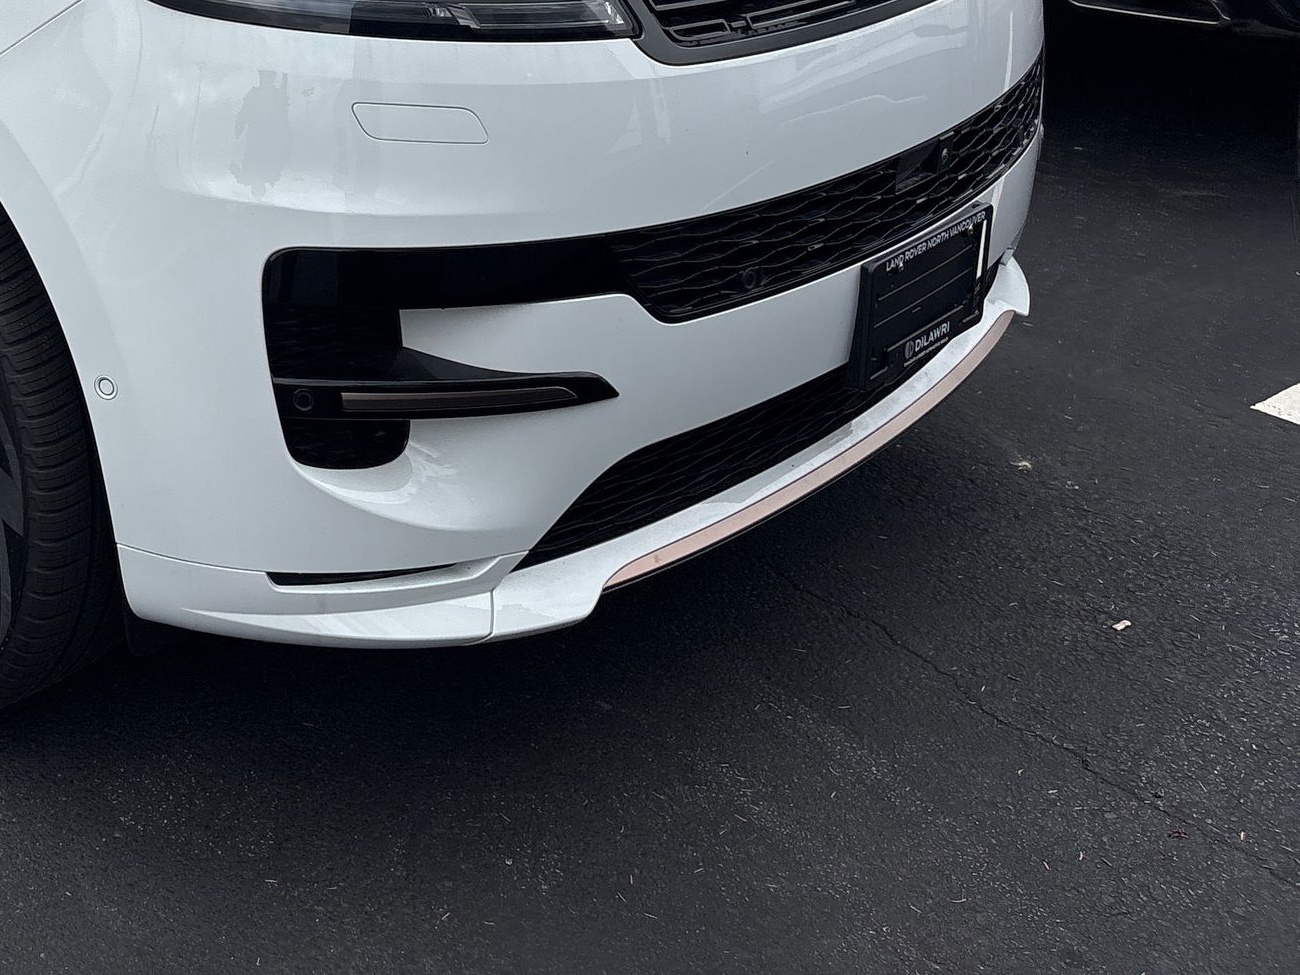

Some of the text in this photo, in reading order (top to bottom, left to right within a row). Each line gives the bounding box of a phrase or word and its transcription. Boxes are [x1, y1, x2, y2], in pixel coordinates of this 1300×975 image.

[886, 254, 905, 272] LAND
[905, 241, 928, 261] ROVER
[927, 230, 950, 251] NORTH
[914, 320, 950, 353] DILAWRI
